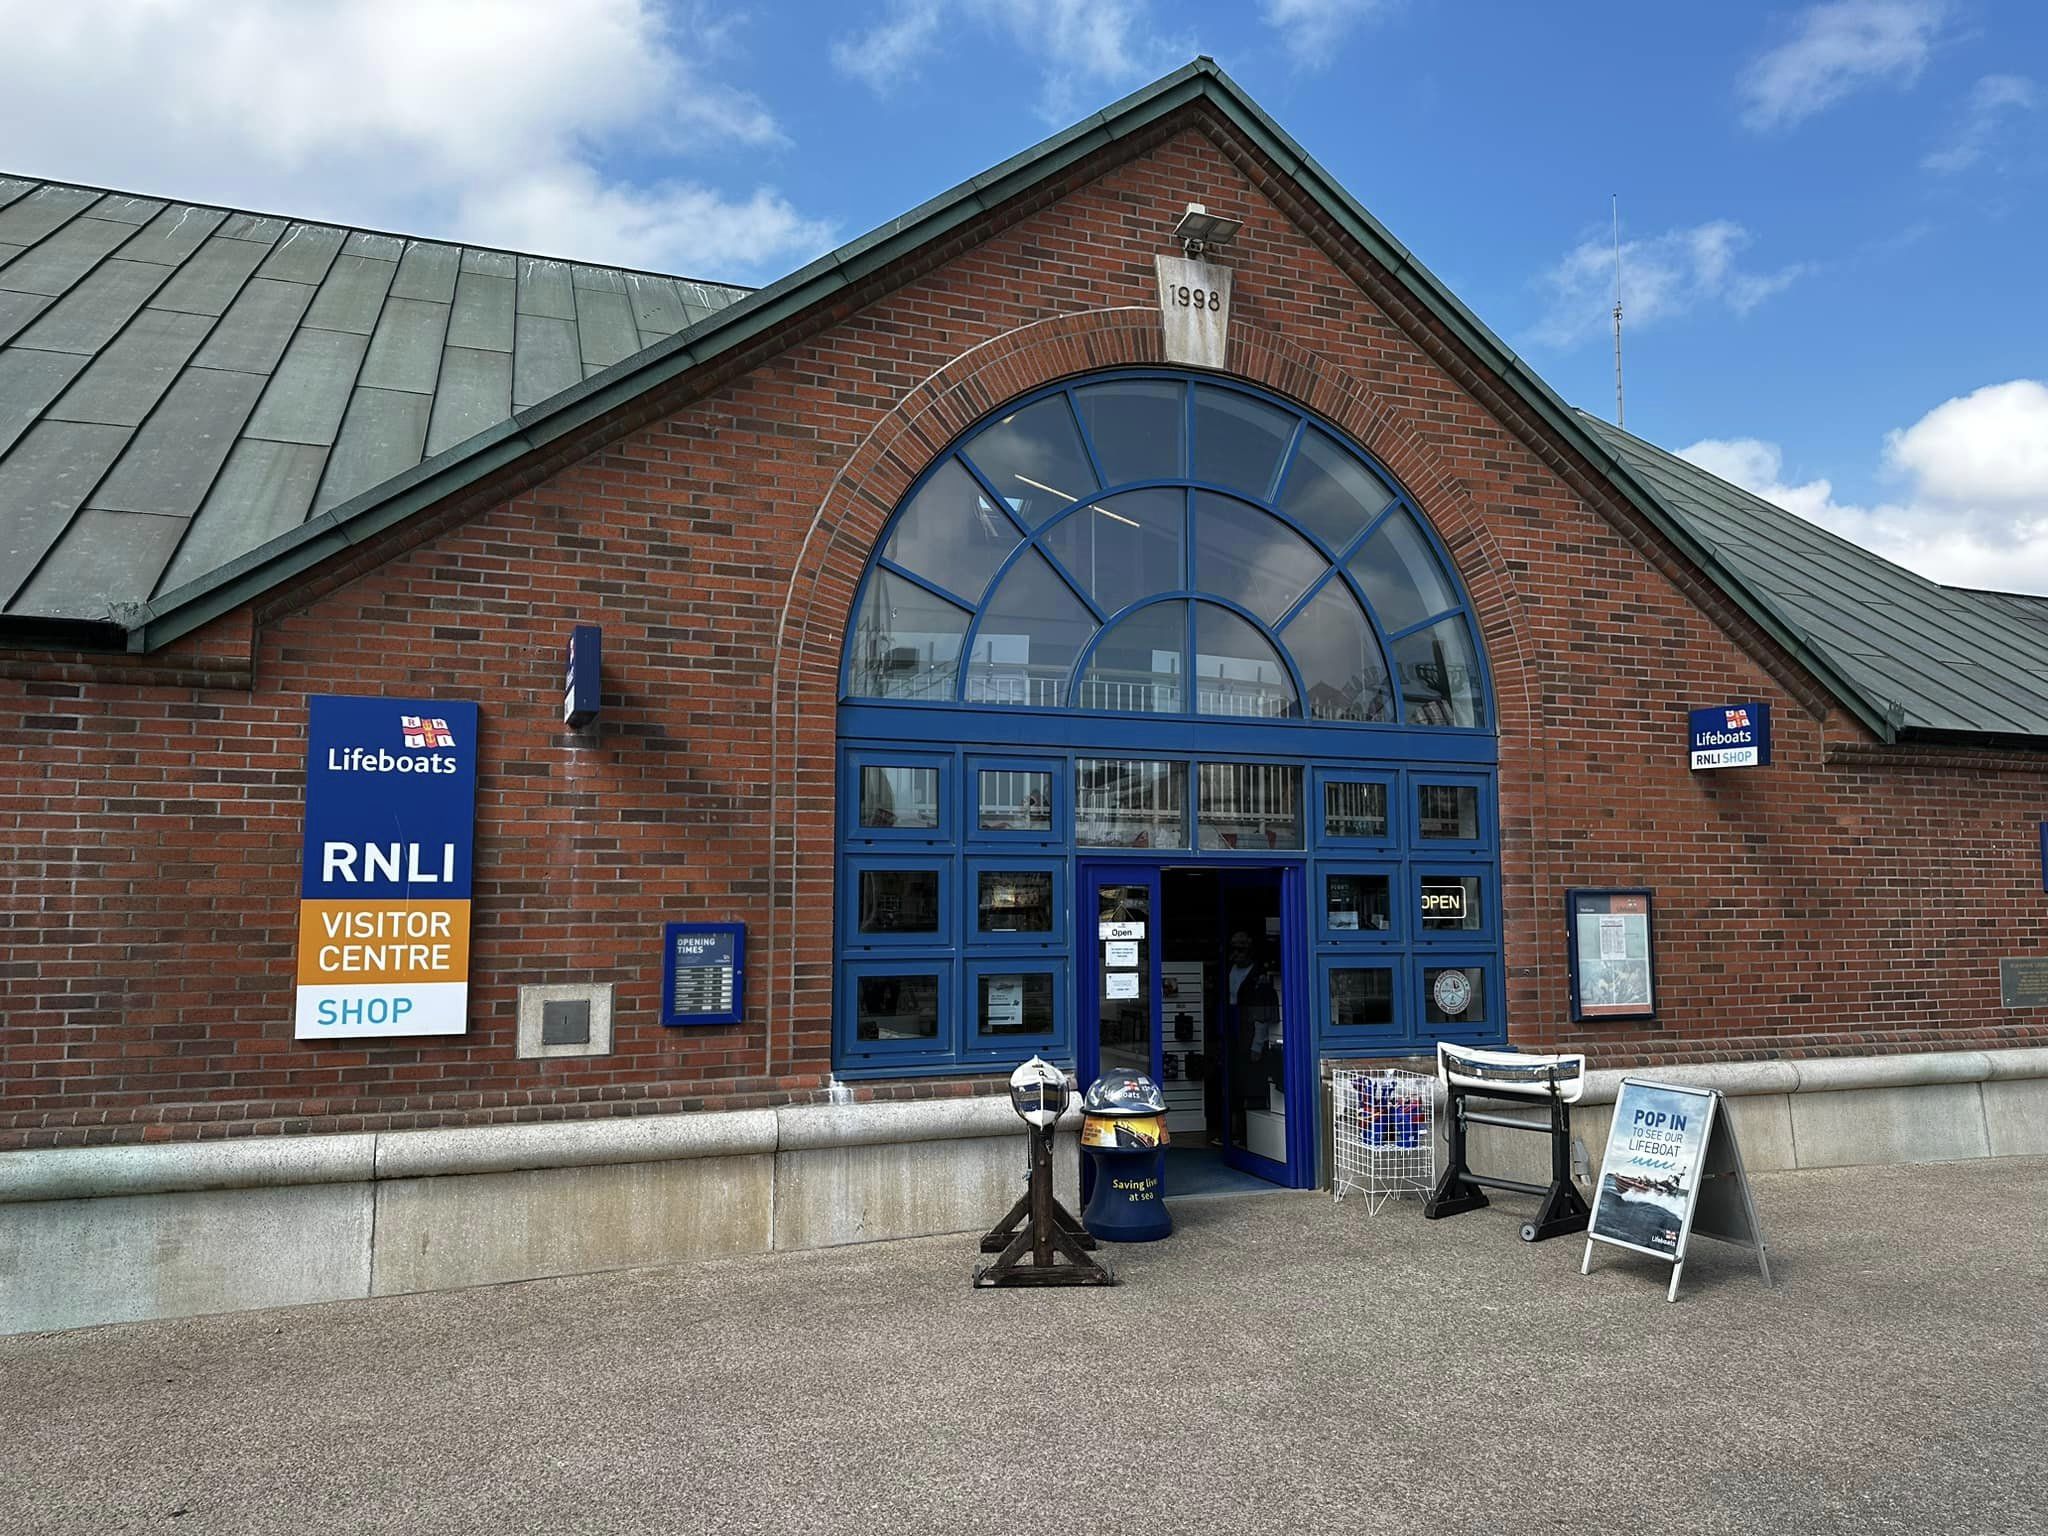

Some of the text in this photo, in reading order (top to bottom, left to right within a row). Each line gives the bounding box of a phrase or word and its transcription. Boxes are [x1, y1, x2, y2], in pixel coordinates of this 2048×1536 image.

[1169, 284, 1220, 312] 1998
[1696, 730, 1752, 746] Lifeboats
[328, 748, 457, 774] Lifeboats
[1696, 750, 1752, 766] RNLI SHOP
[322, 842, 455, 883] RNLI
[1421, 895, 1460, 910] OPEN
[321, 911, 452, 938] VISITOR
[1111, 928, 1133, 937] Open
[677, 938, 716, 946] OPENING
[677, 946, 704, 954] TIMES
[319, 944, 451, 972] CENTRE
[317, 998, 413, 1026] SHOP
[1633, 1109, 1687, 1131] POP IN
[1633, 1127, 1683, 1143] TO SEE OUR
[1628, 1138, 1681, 1158] LIFEBOAT
[1112, 1178, 1145, 1191] Saving
[1129, 1192, 1154, 1202] at sea
[1651, 1235, 1676, 1247] Lifeboats
